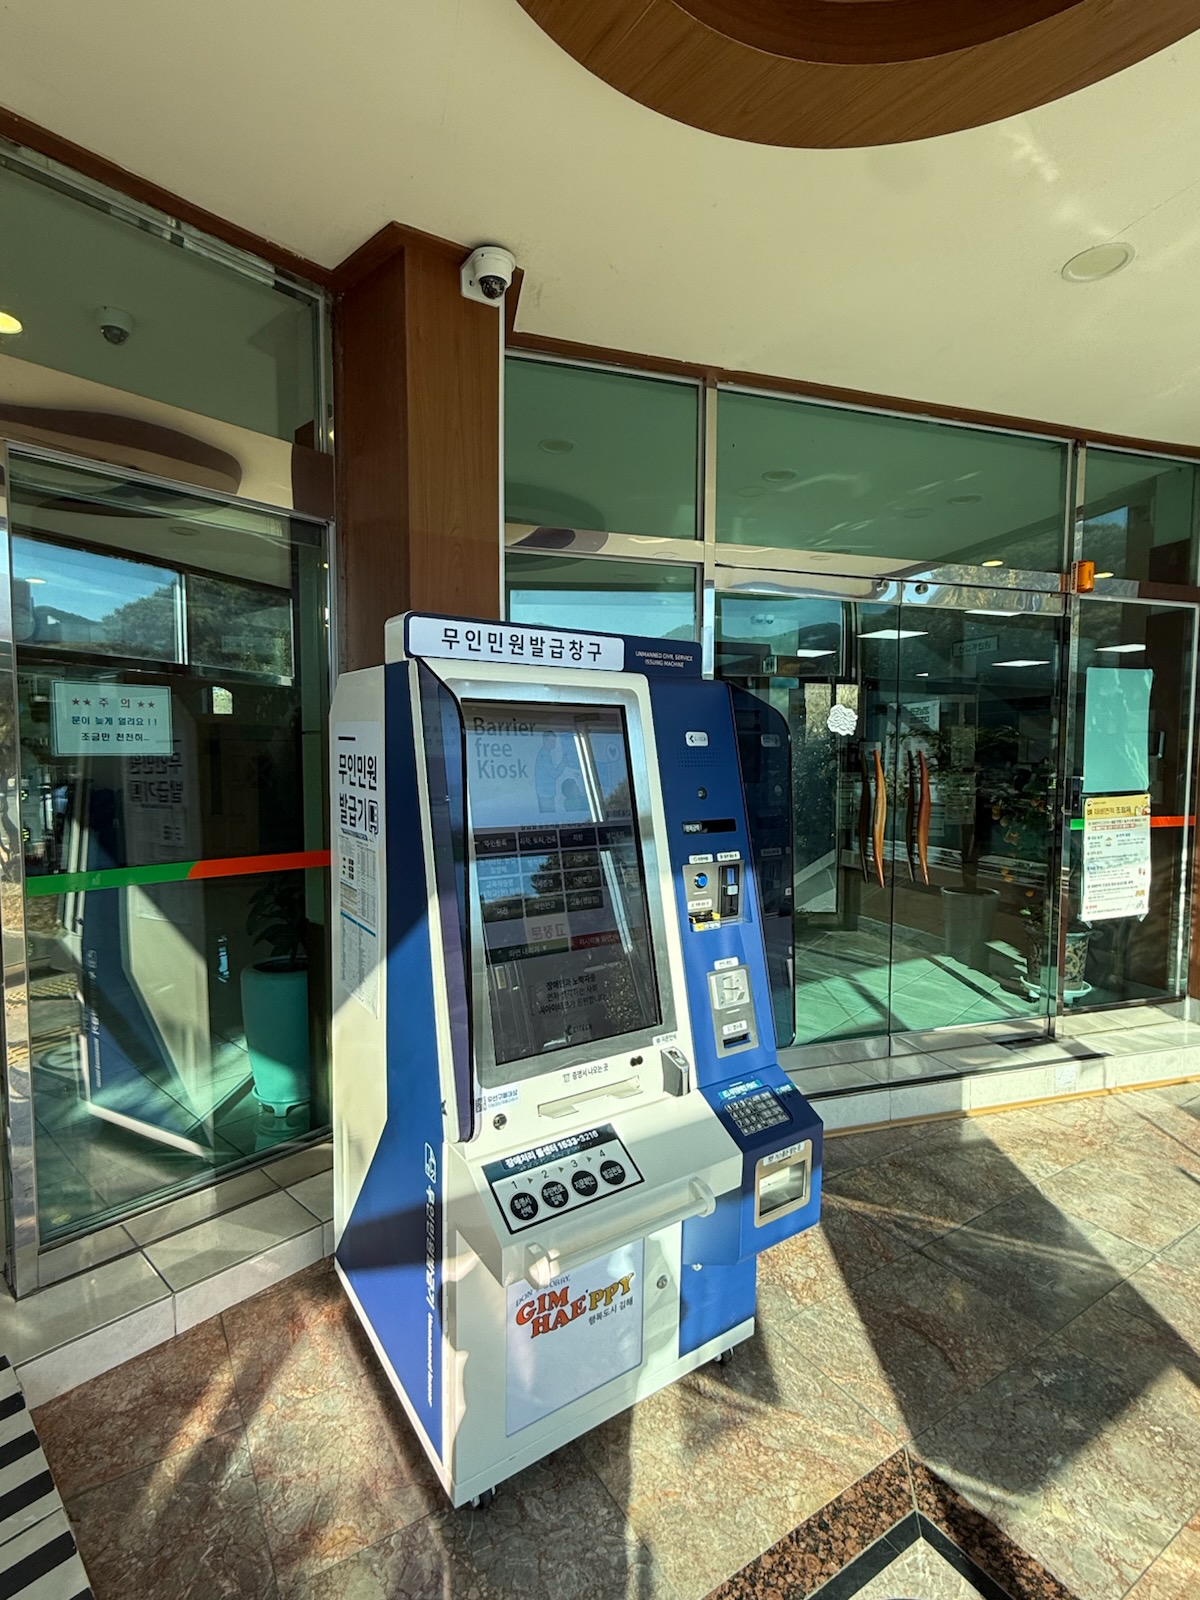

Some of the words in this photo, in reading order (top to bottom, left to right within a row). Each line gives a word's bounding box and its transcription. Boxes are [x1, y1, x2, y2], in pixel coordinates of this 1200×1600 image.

[441, 627, 602, 662] 무인민원발급창구
[635, 650, 662, 660] UNMANNED
[644, 659, 663, 667] ISSUING
[664, 660, 684, 668] MACHINE
[72, 716, 90, 725] 문이
[473, 717, 536, 737] Barrier
[82, 732, 110, 742] 조금만
[475, 737, 512, 758] free
[338, 754, 377, 791] 무인민원
[477, 759, 529, 779] Kiosk
[339, 793, 367, 832] 발급기
[505, 1150, 537, 1168] 장애처리
[511, 1181, 518, 1189] 1
[541, 1170, 549, 1179] 2
[570, 1159, 578, 1168] 3
[599, 1149, 606, 1157] 4
[516, 1285, 570, 1326] GIM
[588, 1304, 618, 1326] 행복도시
[619, 1296, 634, 1311] 김해
